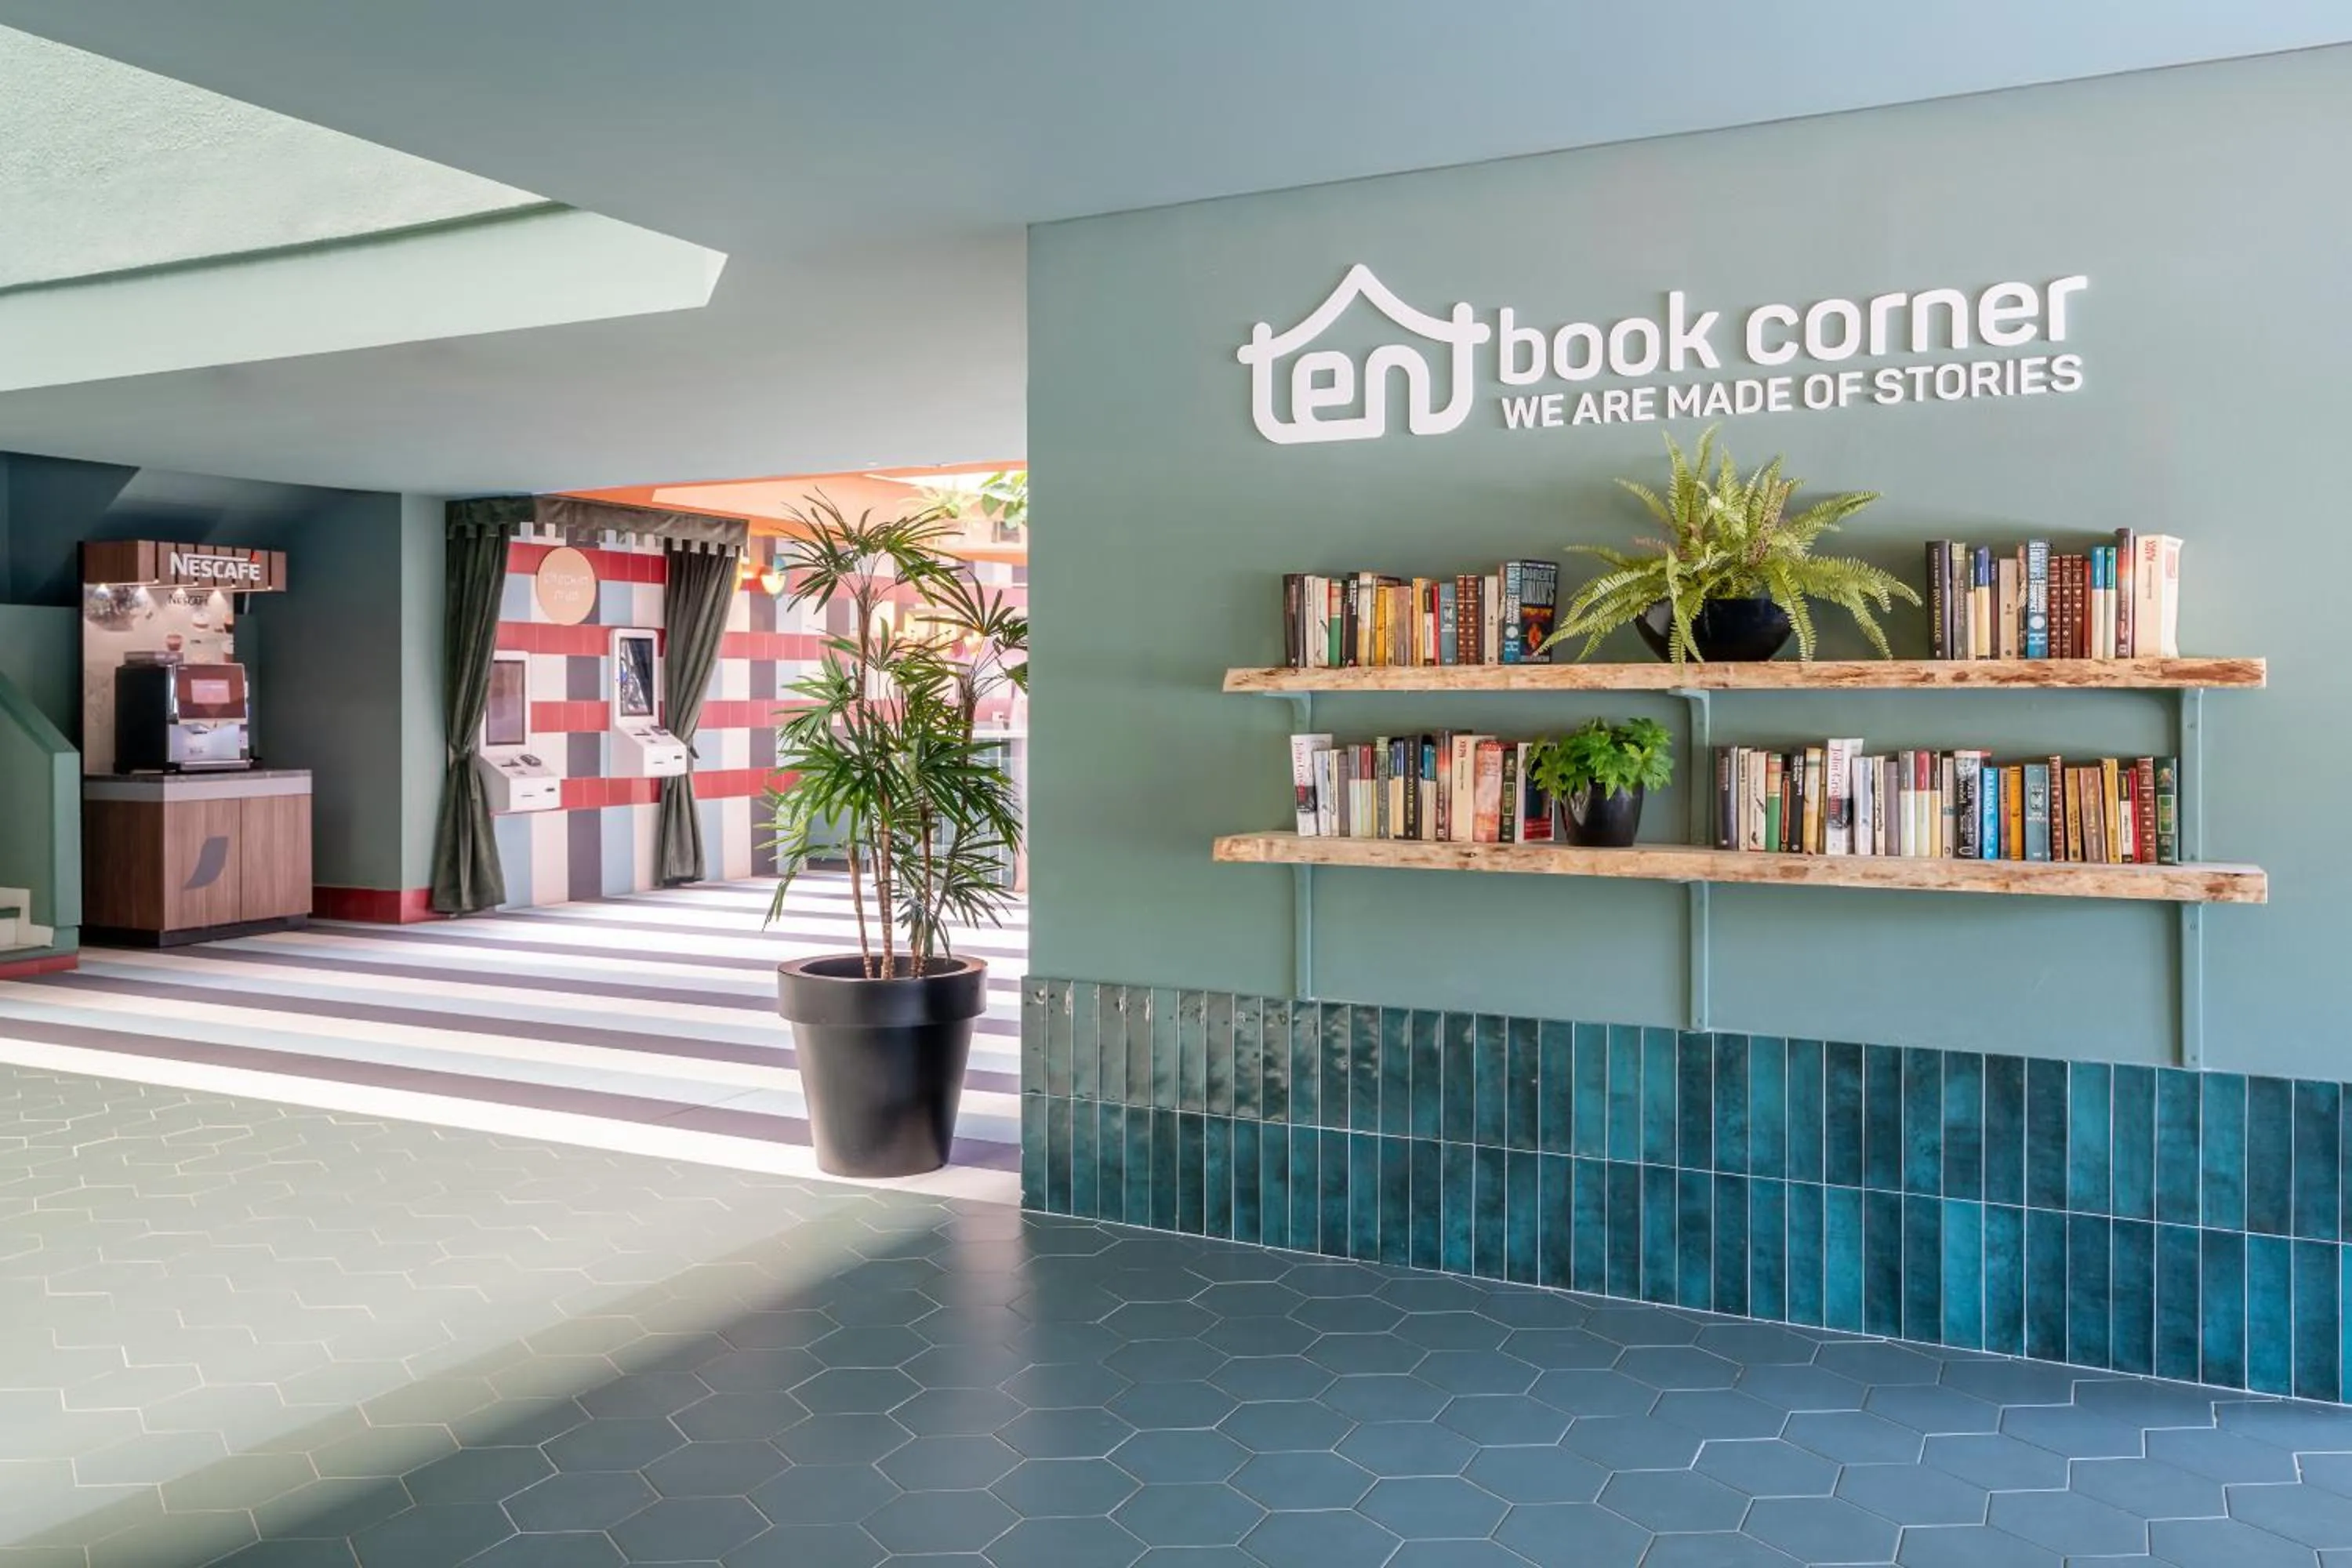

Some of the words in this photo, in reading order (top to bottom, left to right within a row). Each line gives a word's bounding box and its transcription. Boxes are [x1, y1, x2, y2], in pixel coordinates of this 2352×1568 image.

[1236, 263, 1491, 445] tent
[1499, 291, 1721, 385] book
[1746, 274, 2089, 366] corner
[1501, 393, 1565, 430] WE
[1571, 387, 1657, 426] ARE
[1667, 376, 1794, 419] MADE
[1803, 370, 1864, 411] OF
[1874, 354, 2084, 405] STORIES
